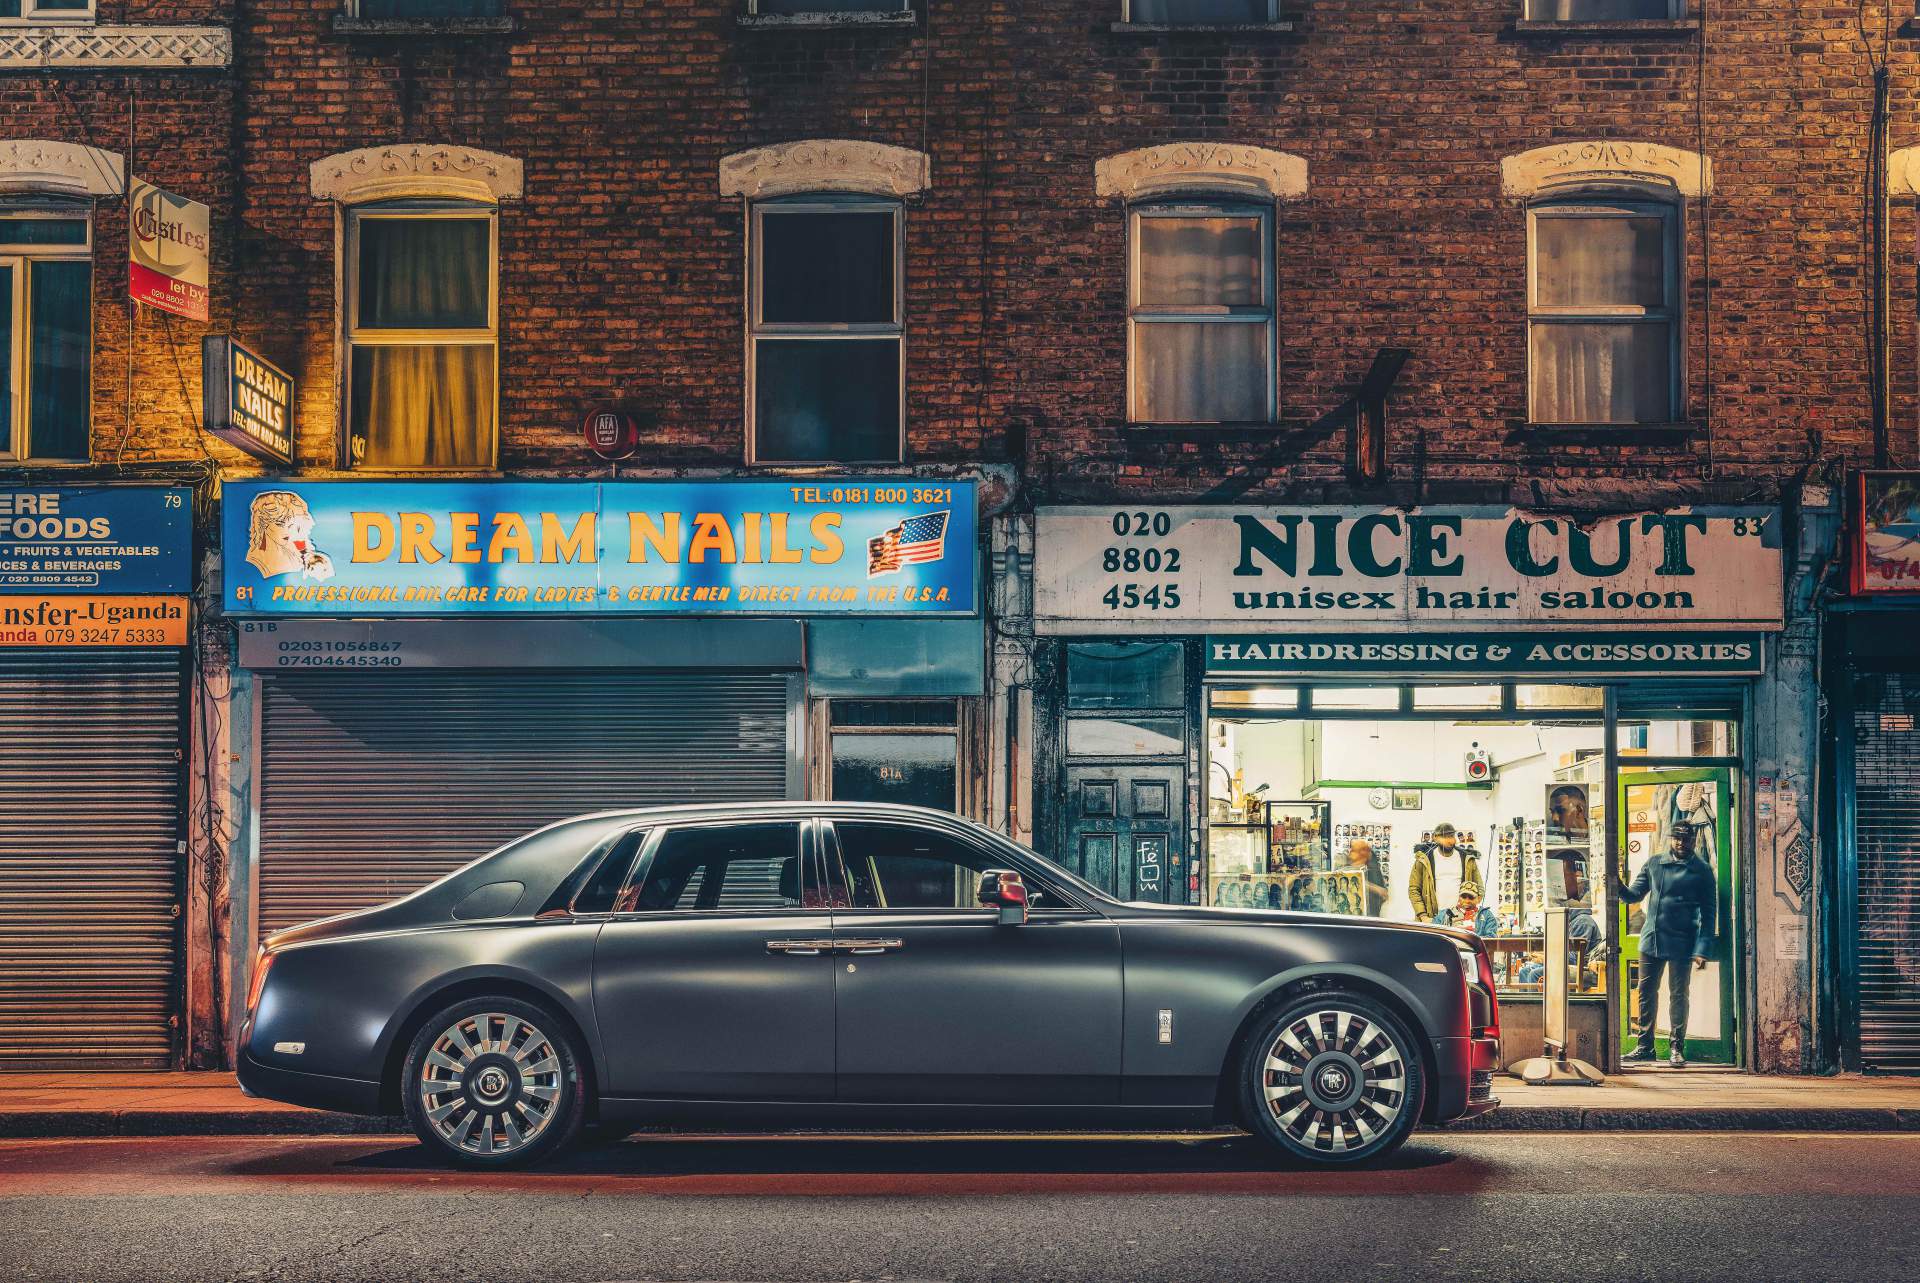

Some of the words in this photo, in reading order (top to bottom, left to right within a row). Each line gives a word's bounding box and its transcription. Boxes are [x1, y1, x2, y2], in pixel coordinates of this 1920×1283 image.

[133, 207, 204, 251] Castles
[170, 280, 186, 295] let
[190, 286, 205, 302] by
[235, 351, 286, 407] DREAM
[239, 382, 285, 433] NAILS
[599, 416, 614, 430] AFA
[164, 495, 181, 508] 79
[874, 488, 907, 503] 800
[912, 488, 951, 503] 3621
[0, 518, 111, 539] FOODS
[1112, 512, 1171, 536] 020
[1733, 517, 1763, 537] 83
[350, 511, 598, 565] DREAM
[626, 512, 845, 565] NAILS
[1233, 514, 1464, 578] NICE
[1505, 514, 1707, 577] CUT
[14, 547, 60, 556] FRUITS
[63, 547, 73, 556] &
[76, 547, 160, 556] VEGETABLES
[1102, 548, 1181, 573] 8802
[0, 561, 27, 571] CES
[31, 561, 40, 571] &
[44, 561, 121, 571] BEVERAGES
[236, 586, 253, 600] 81
[272, 586, 400, 602] PROFESSIONAL
[403, 586, 442, 602] NAIL
[445, 586, 489, 602] CARE
[495, 586, 529, 602] FOR
[533, 586, 597, 602] LADIES
[607, 586, 621, 602] &
[738, 586, 801, 602] DIRECT
[807, 586, 858, 602] FROM
[866, 586, 899, 602] THE
[903, 586, 951, 602] U.S.A.
[1102, 584, 1181, 610] 4545
[1233, 586, 1396, 610] unisex
[1416, 586, 1517, 609] hair
[1540, 586, 1695, 609] saloon
[0, 602, 182, 625] nsfer-Uganda
[45, 629, 75, 643] 079
[80, 629, 120, 643] 3247
[125, 629, 165, 643] 5333
[244, 622, 278, 633] 81B
[278, 641, 402, 652] 02031056867
[1212, 643, 1478, 661] HAIRDRESSING
[1485, 644, 1512, 661] &
[1527, 643, 1752, 661] ACCESSORIES
[278, 656, 401, 666] 07404645340
[880, 767, 903, 781] 81A
